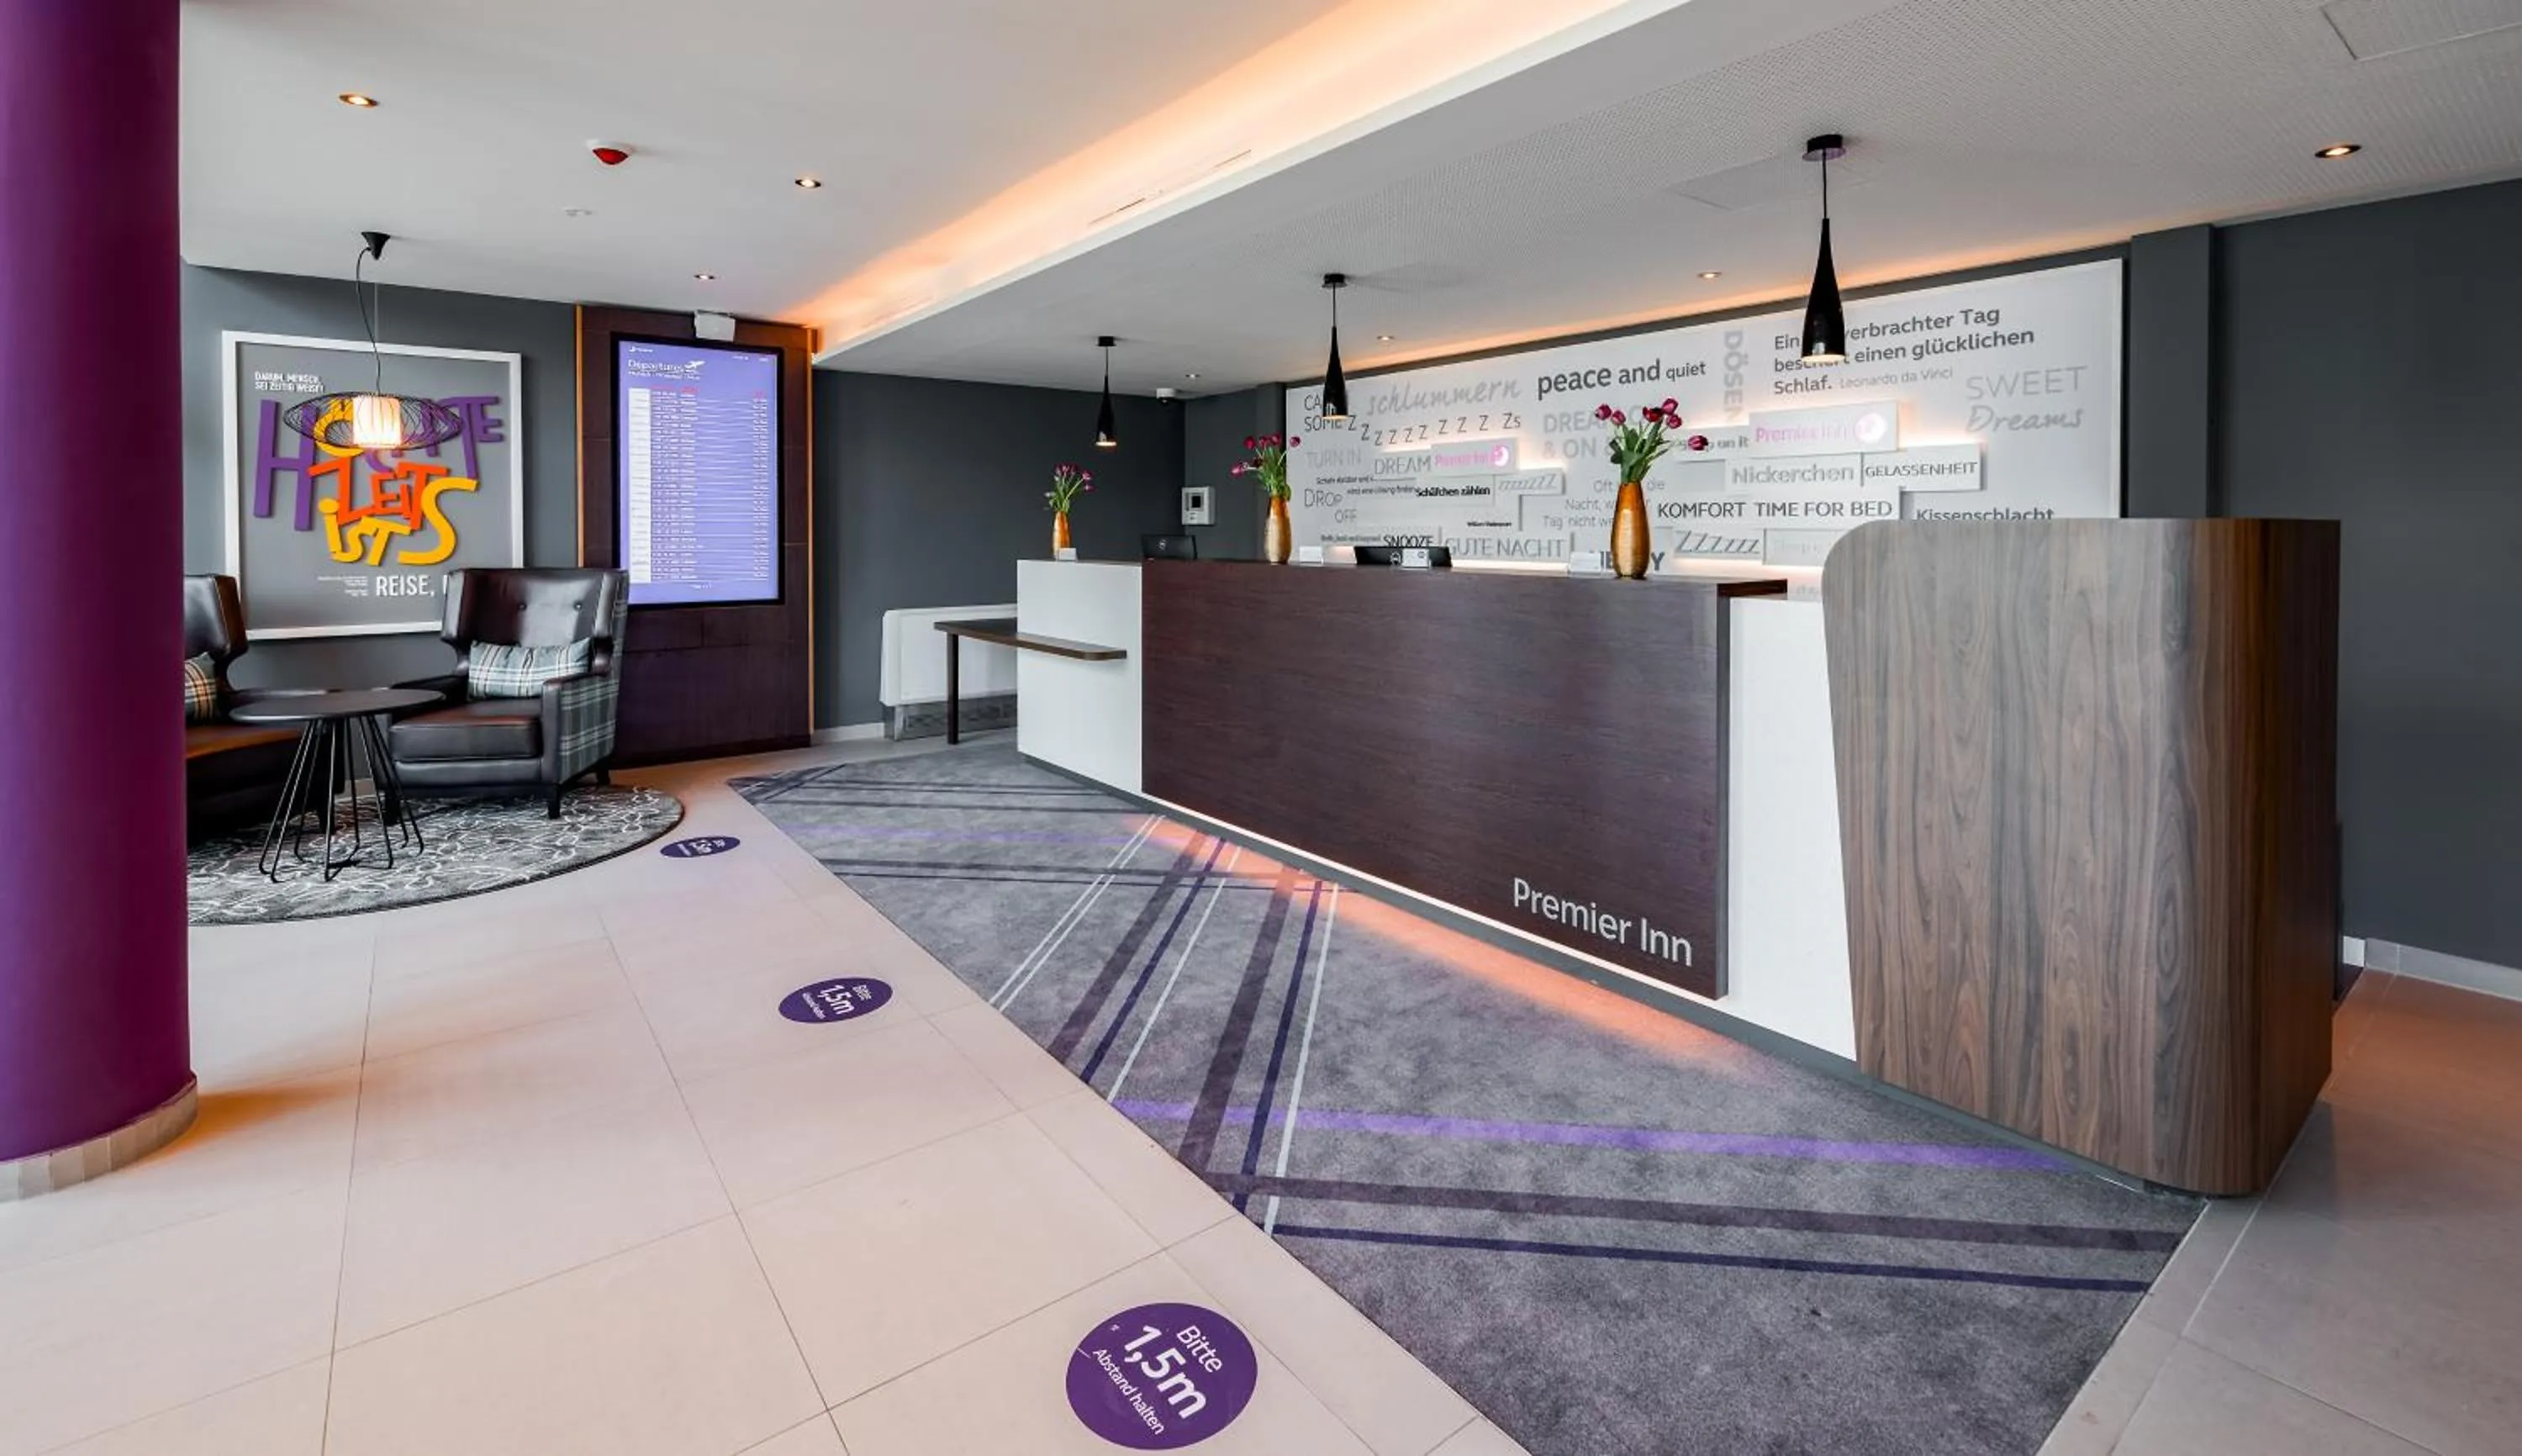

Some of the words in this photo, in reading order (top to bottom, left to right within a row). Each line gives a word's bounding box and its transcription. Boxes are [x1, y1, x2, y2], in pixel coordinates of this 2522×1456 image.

[1775, 333, 1800, 351] Ein
[1960, 308, 2001, 327] Tag
[1855, 344, 1907, 364] einen
[1912, 327, 2035, 361] glücklichen
[1537, 367, 1612, 401] peace
[1618, 357, 1660, 385] and
[1665, 361, 1707, 381] quiet
[1774, 374, 1833, 395] Schlaf.
[1901, 370, 1918, 383] da
[1965, 364, 2088, 401] SWEET
[1367, 377, 1522, 416] schlummern
[1543, 409, 1606, 435] DREA
[1965, 404, 2085, 434] Dreams
[1562, 435, 1597, 459] ON
[1374, 454, 1432, 475] DREAM
[1730, 462, 1854, 485] Nickerchen
[1865, 461, 1978, 478] GELASSENHEIT
[308, 456, 449, 530] ZEIT
[1304, 488, 1343, 508] DROP
[1461, 484, 1491, 496] zählen
[1334, 509, 1358, 523] OFF
[1658, 501, 1745, 519] KOMFORT
[1755, 501, 1798, 518] TIME
[1804, 500, 1844, 518] FOR
[1849, 499, 1892, 517] BED
[1543, 515, 1563, 530] Tag
[1383, 534, 1433, 546] SNOOZE
[1444, 537, 1492, 556] GUTE
[1497, 538, 1567, 557] NACHT
[376, 574, 435, 597] REISE,
[1513, 877, 1633, 945] Premier
[1640, 917, 1692, 967] Inn
[1176, 1324, 1223, 1374] Bitte
[1124, 1324, 1207, 1420] 1,5m
[1093, 1348, 1137, 1396] Abstand
[1129, 1386, 1164, 1436] halten
